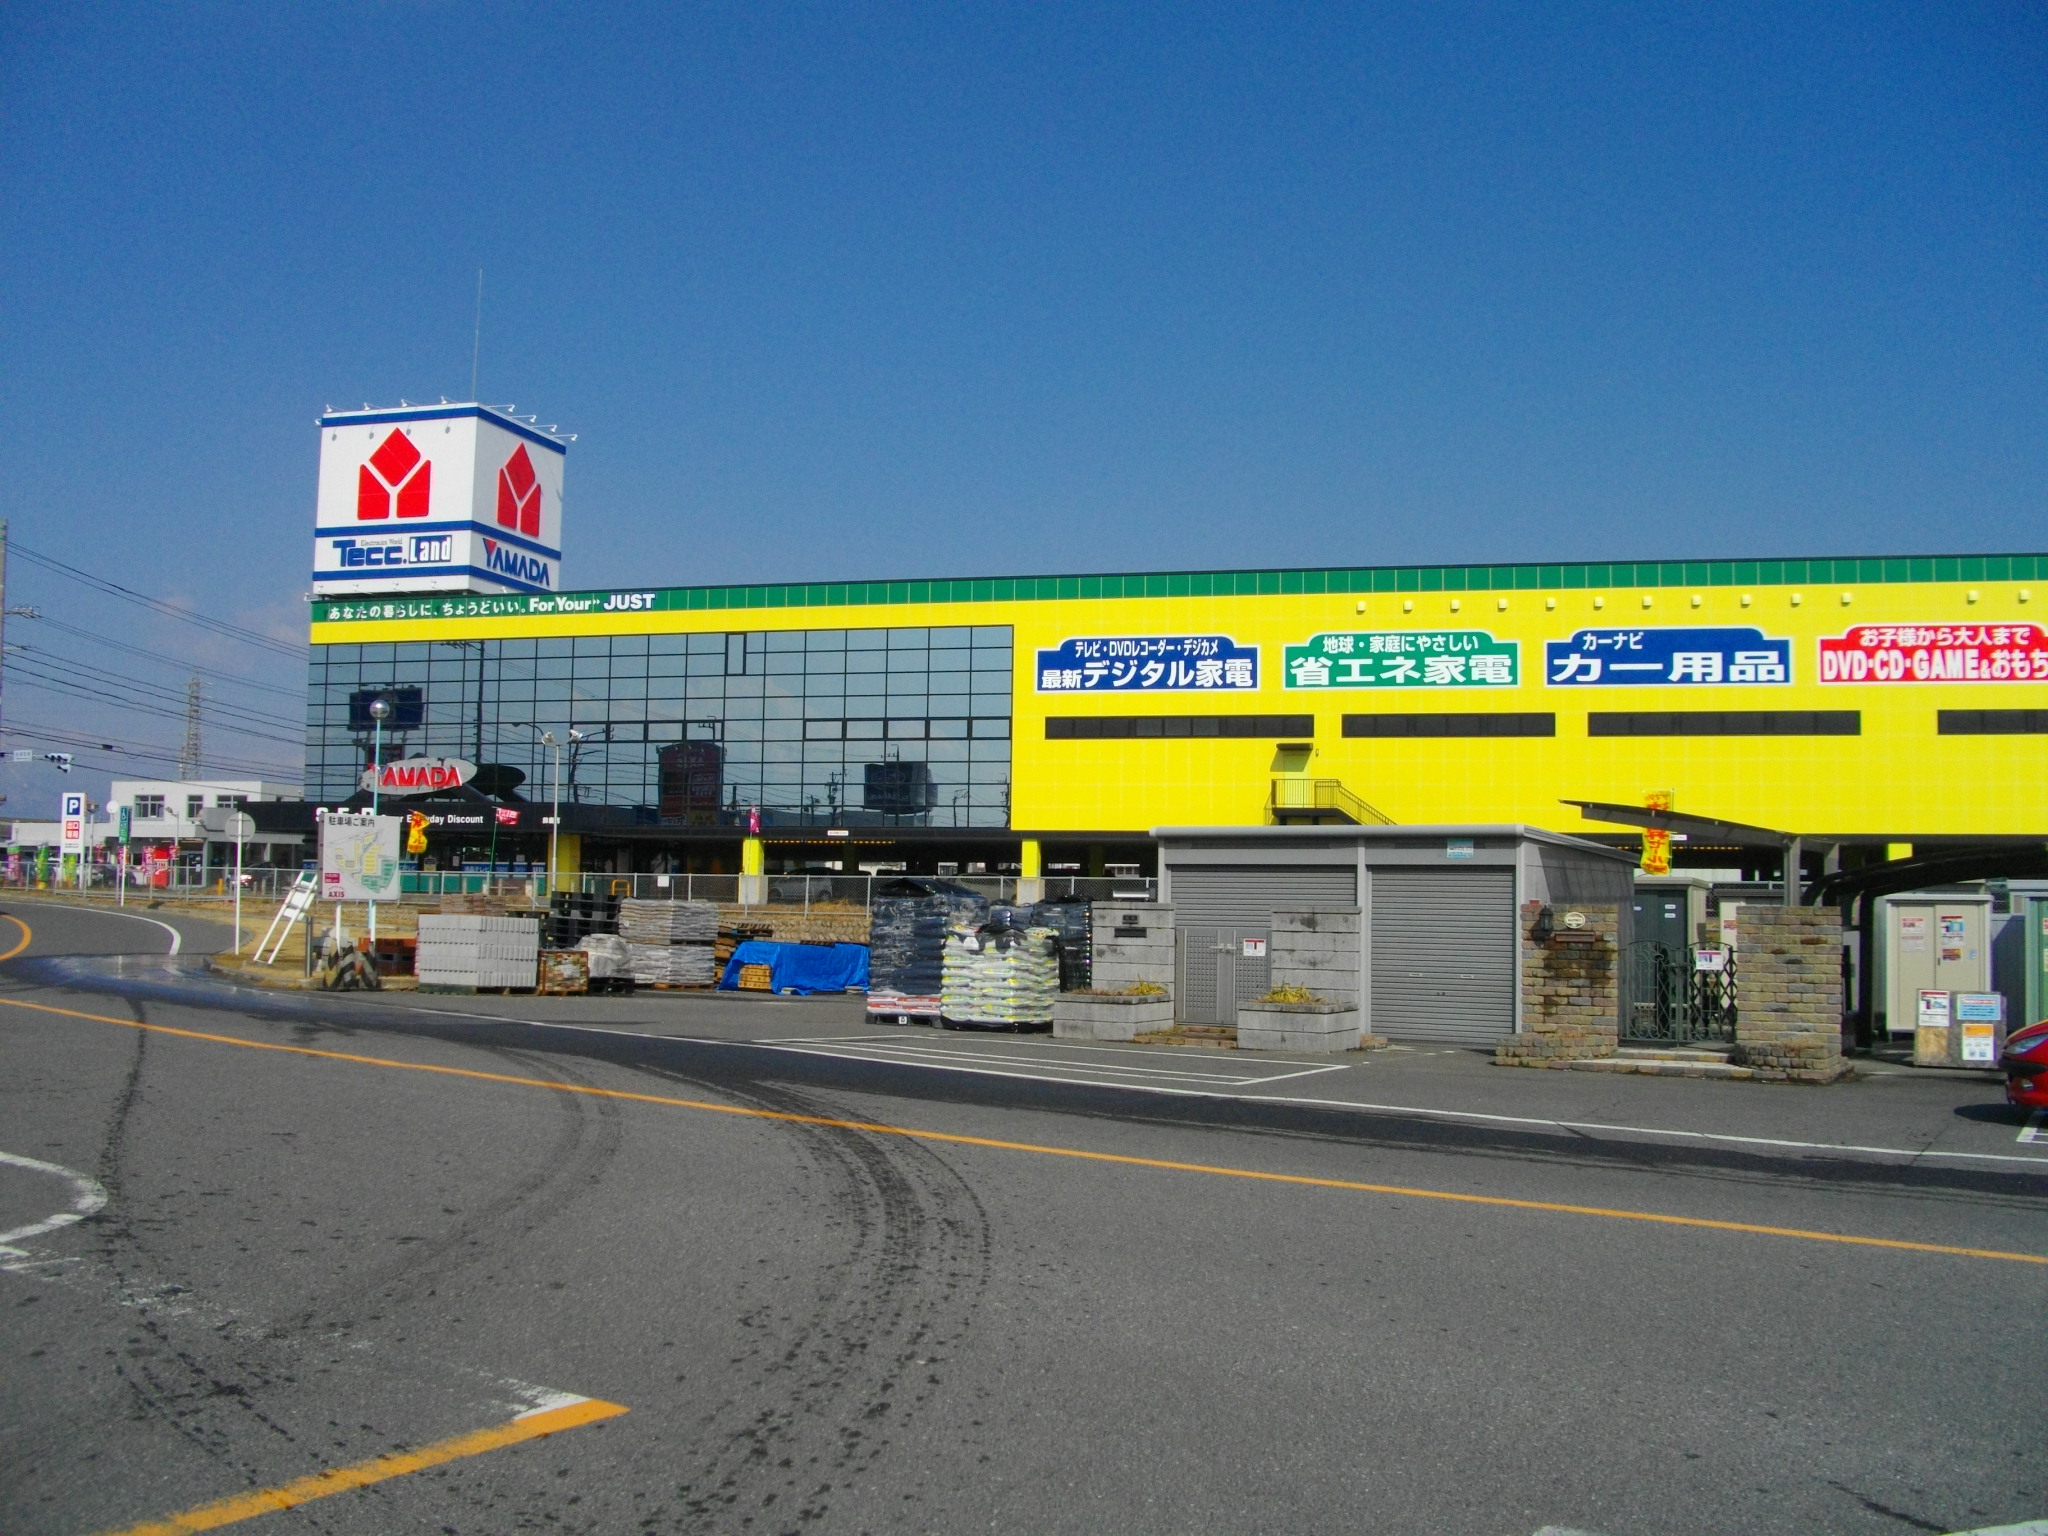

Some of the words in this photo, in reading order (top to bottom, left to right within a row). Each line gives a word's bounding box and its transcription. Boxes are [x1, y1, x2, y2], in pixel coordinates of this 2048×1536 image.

[482, 537, 550, 586] YAMADA
[529, 597, 554, 612] For
[555, 596, 591, 612] Your
[603, 593, 656, 610] JUST
[1322, 634, 1480, 654] 地球・家庭にやさしい
[1582, 631, 1645, 651] カーナビ
[1859, 626, 2031, 647] お子様から大人まで
[1074, 639, 1219, 658] テレビ・DVDレコーダー・デジカメ
[1041, 658, 1254, 689] 最新デジタル家電
[1289, 654, 1514, 686] 省エネ家電
[1550, 650, 1786, 683] カー用品
[367, 762, 463, 789] YAMADA
[68, 799, 80, 814] P
[328, 816, 376, 828] 駐車場ご案内
[447, 814, 484, 824] Discount
